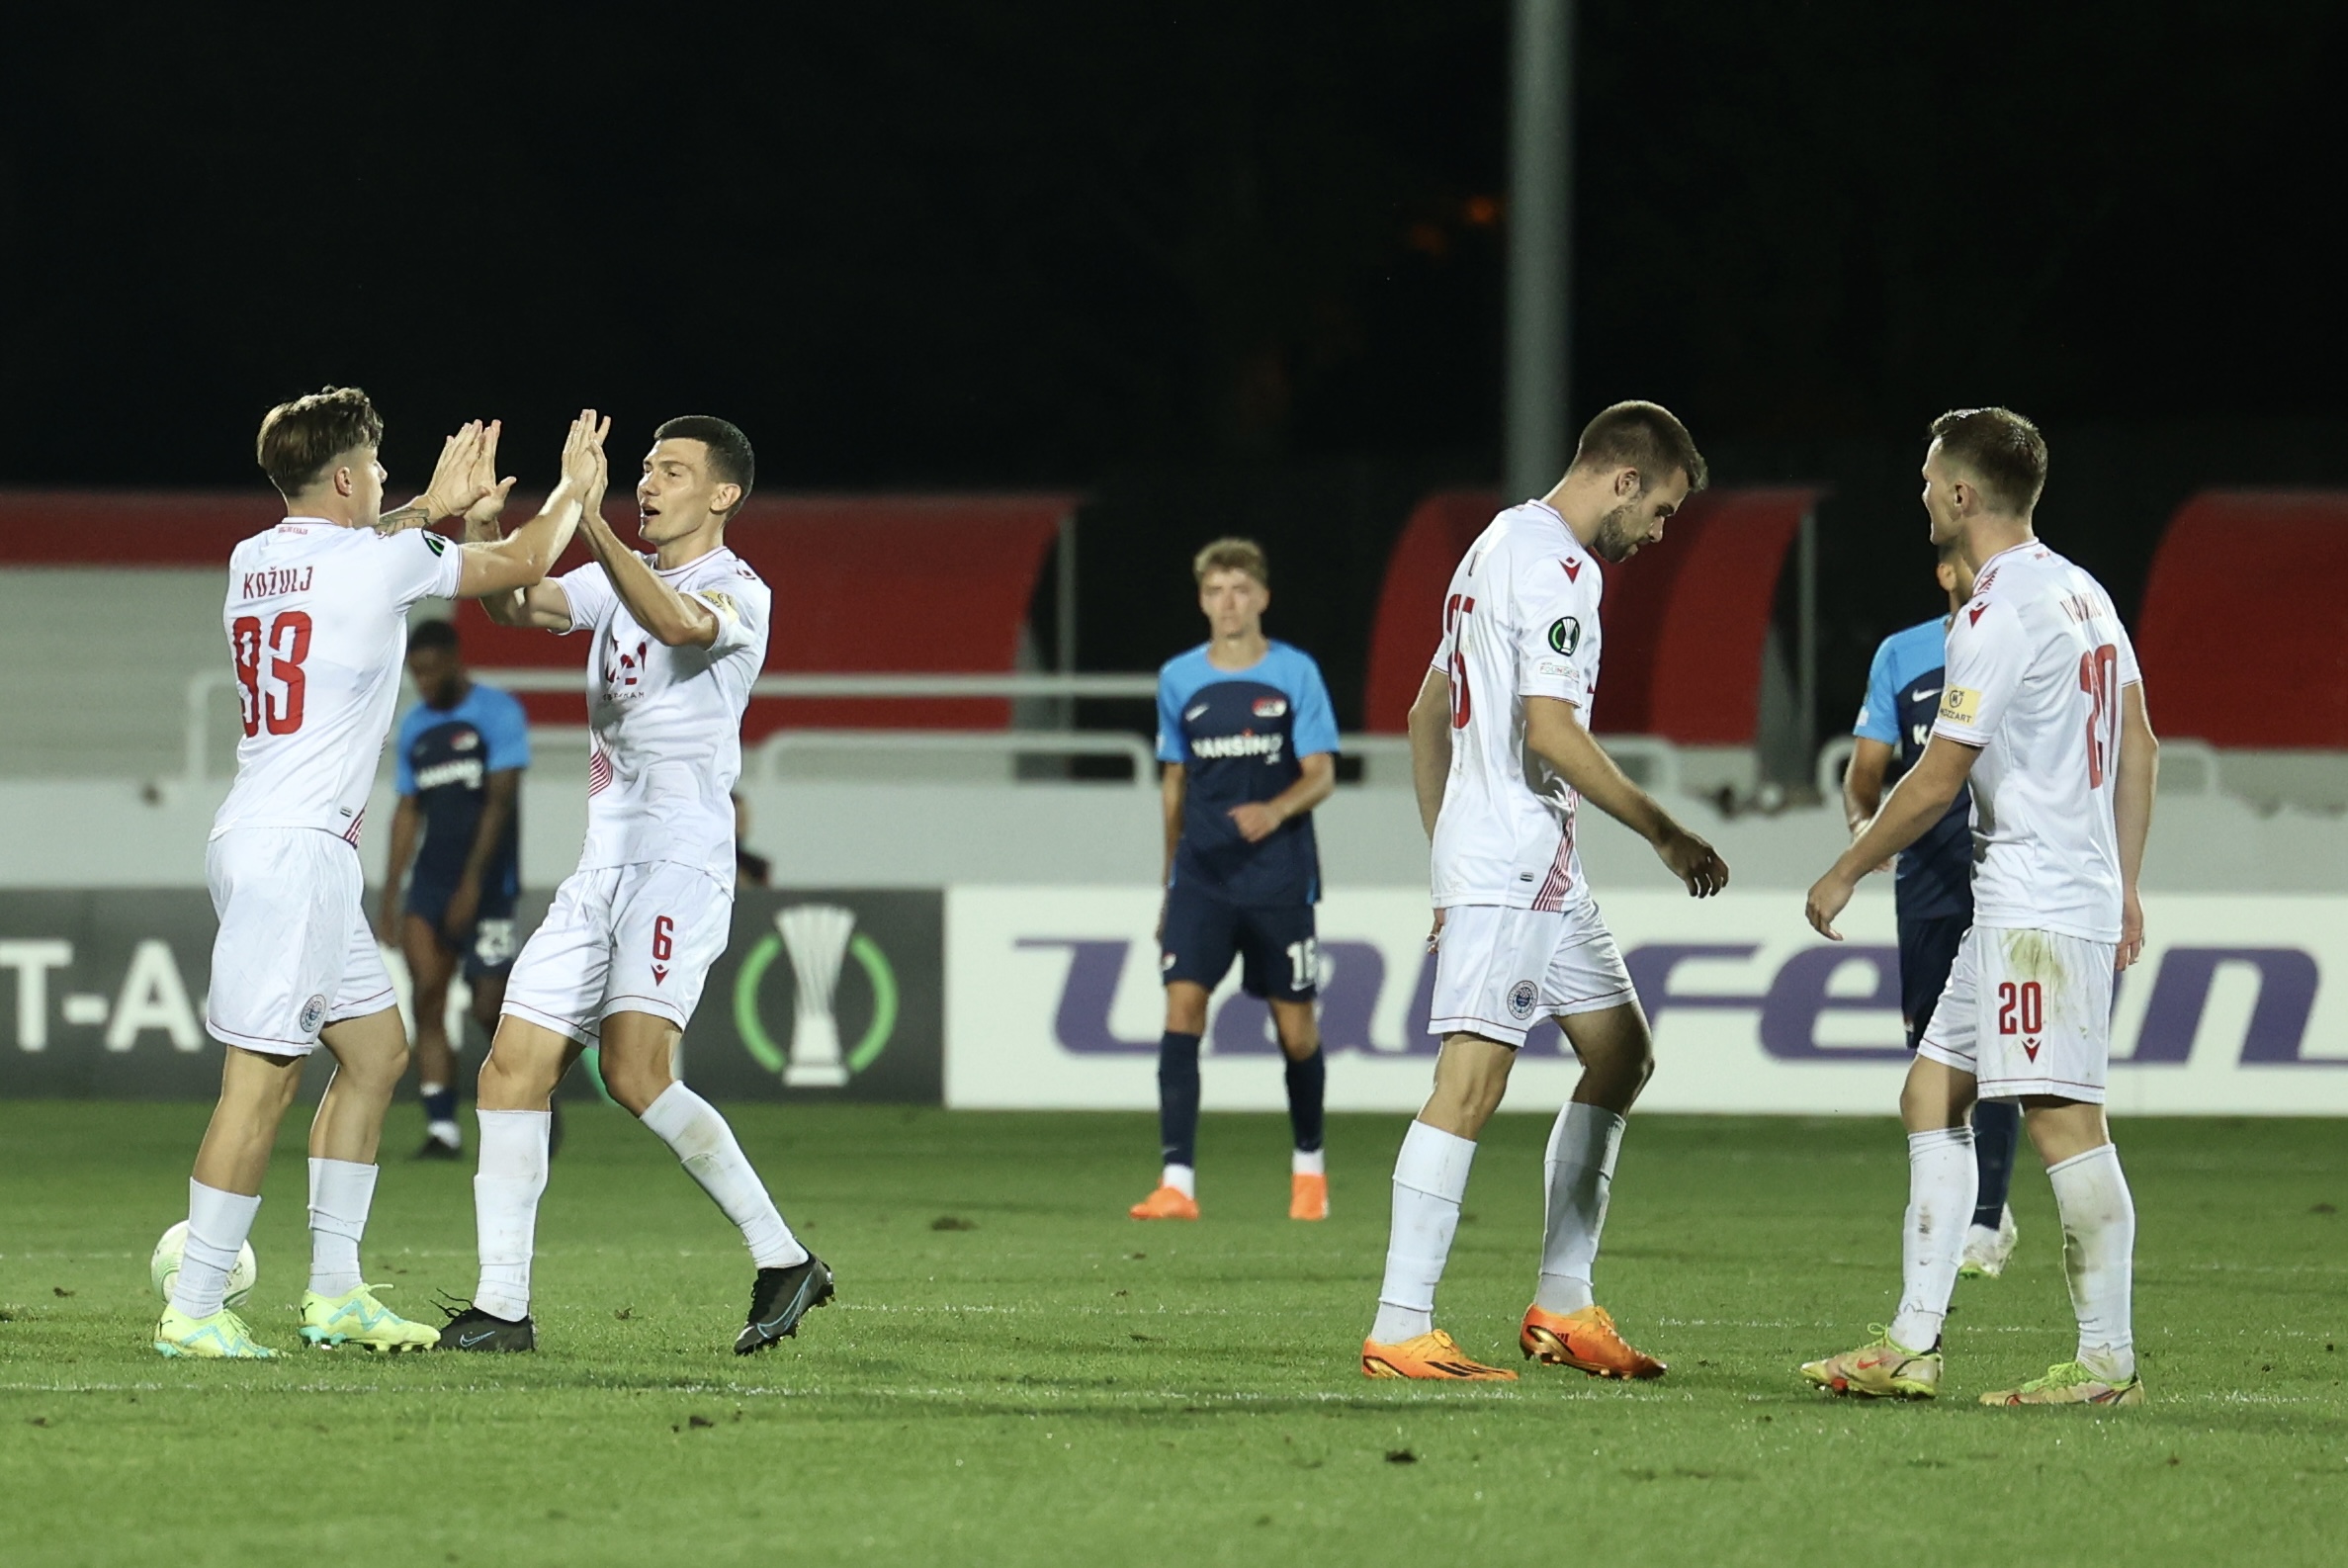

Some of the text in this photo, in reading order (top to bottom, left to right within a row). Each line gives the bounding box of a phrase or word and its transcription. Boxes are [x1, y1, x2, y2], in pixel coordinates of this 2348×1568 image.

[243, 566, 312, 599] KOŽULJ
[652, 915, 673, 961] 6
[1998, 982, 2042, 1034] 20
